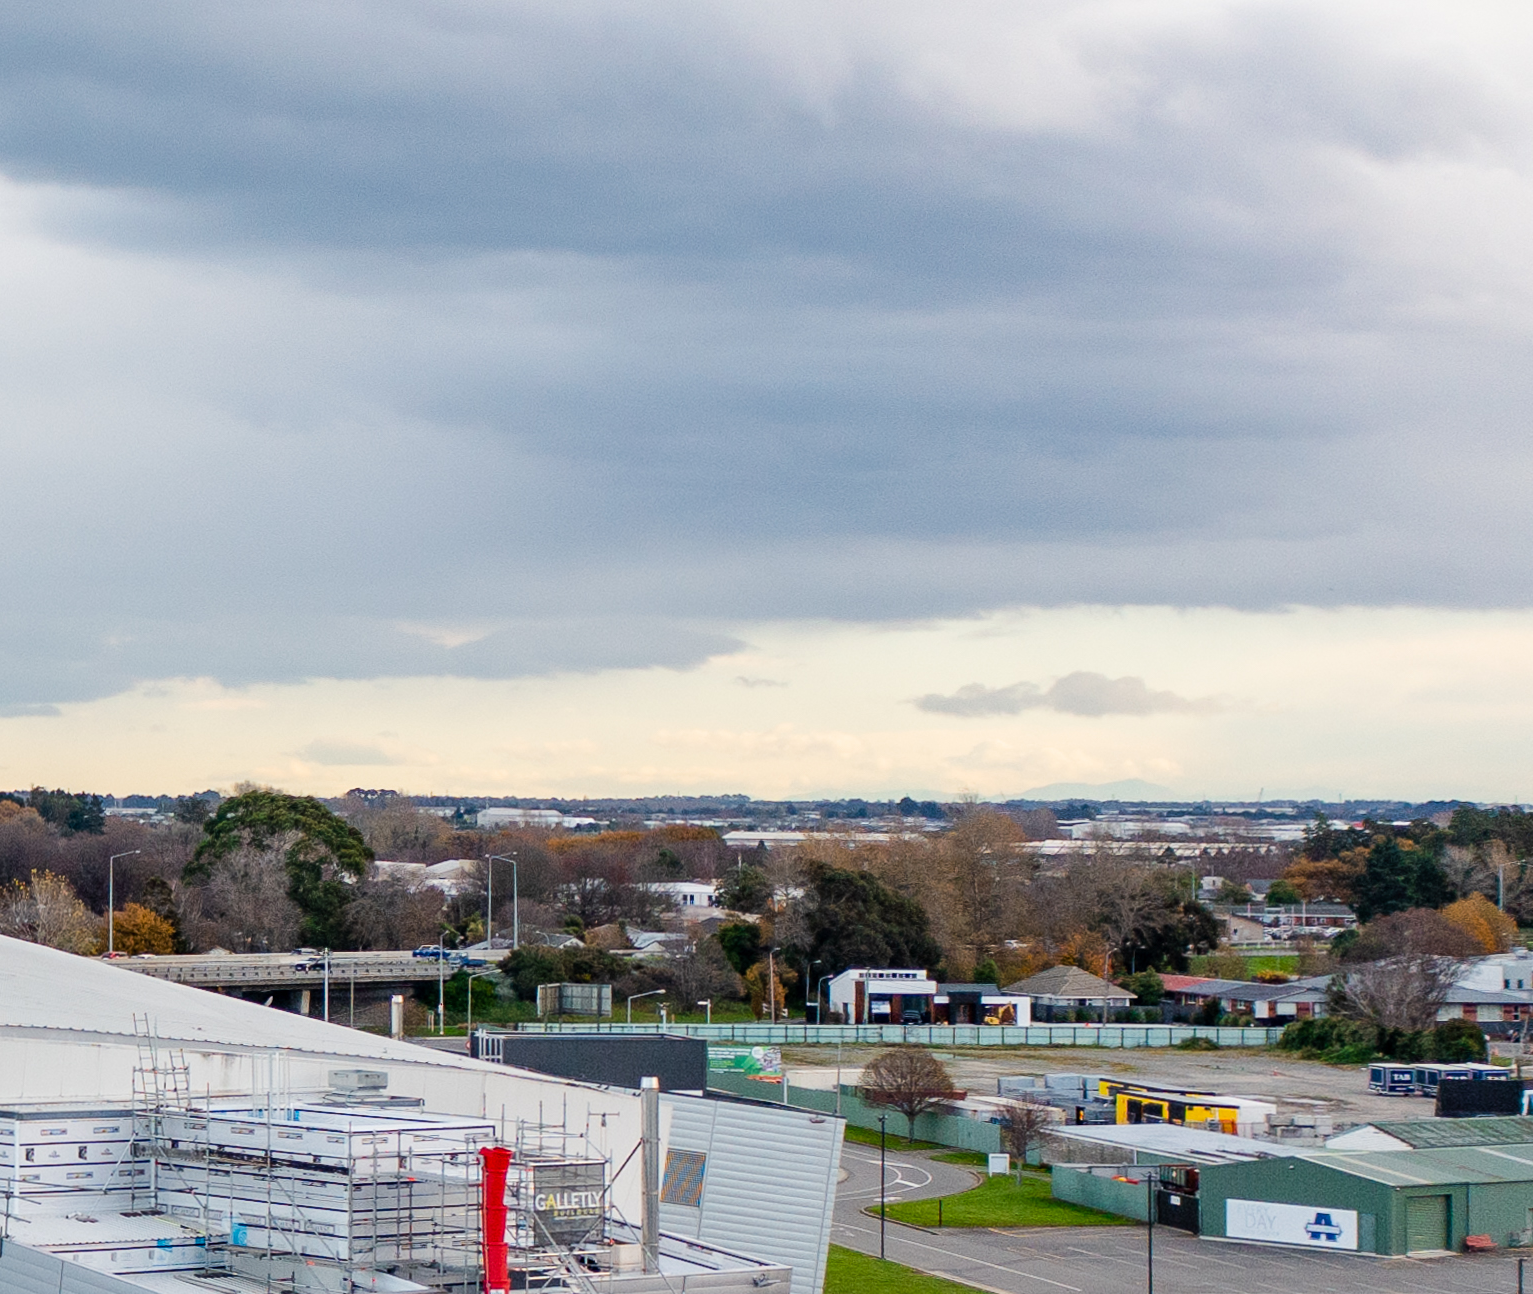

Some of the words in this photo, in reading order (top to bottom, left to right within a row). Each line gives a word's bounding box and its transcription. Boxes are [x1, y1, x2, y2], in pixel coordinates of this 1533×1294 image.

[1392, 1073, 1411, 1081] TAB
[535, 1190, 604, 1211] GALLETLY
[1245, 1213, 1277, 1230] DAY
